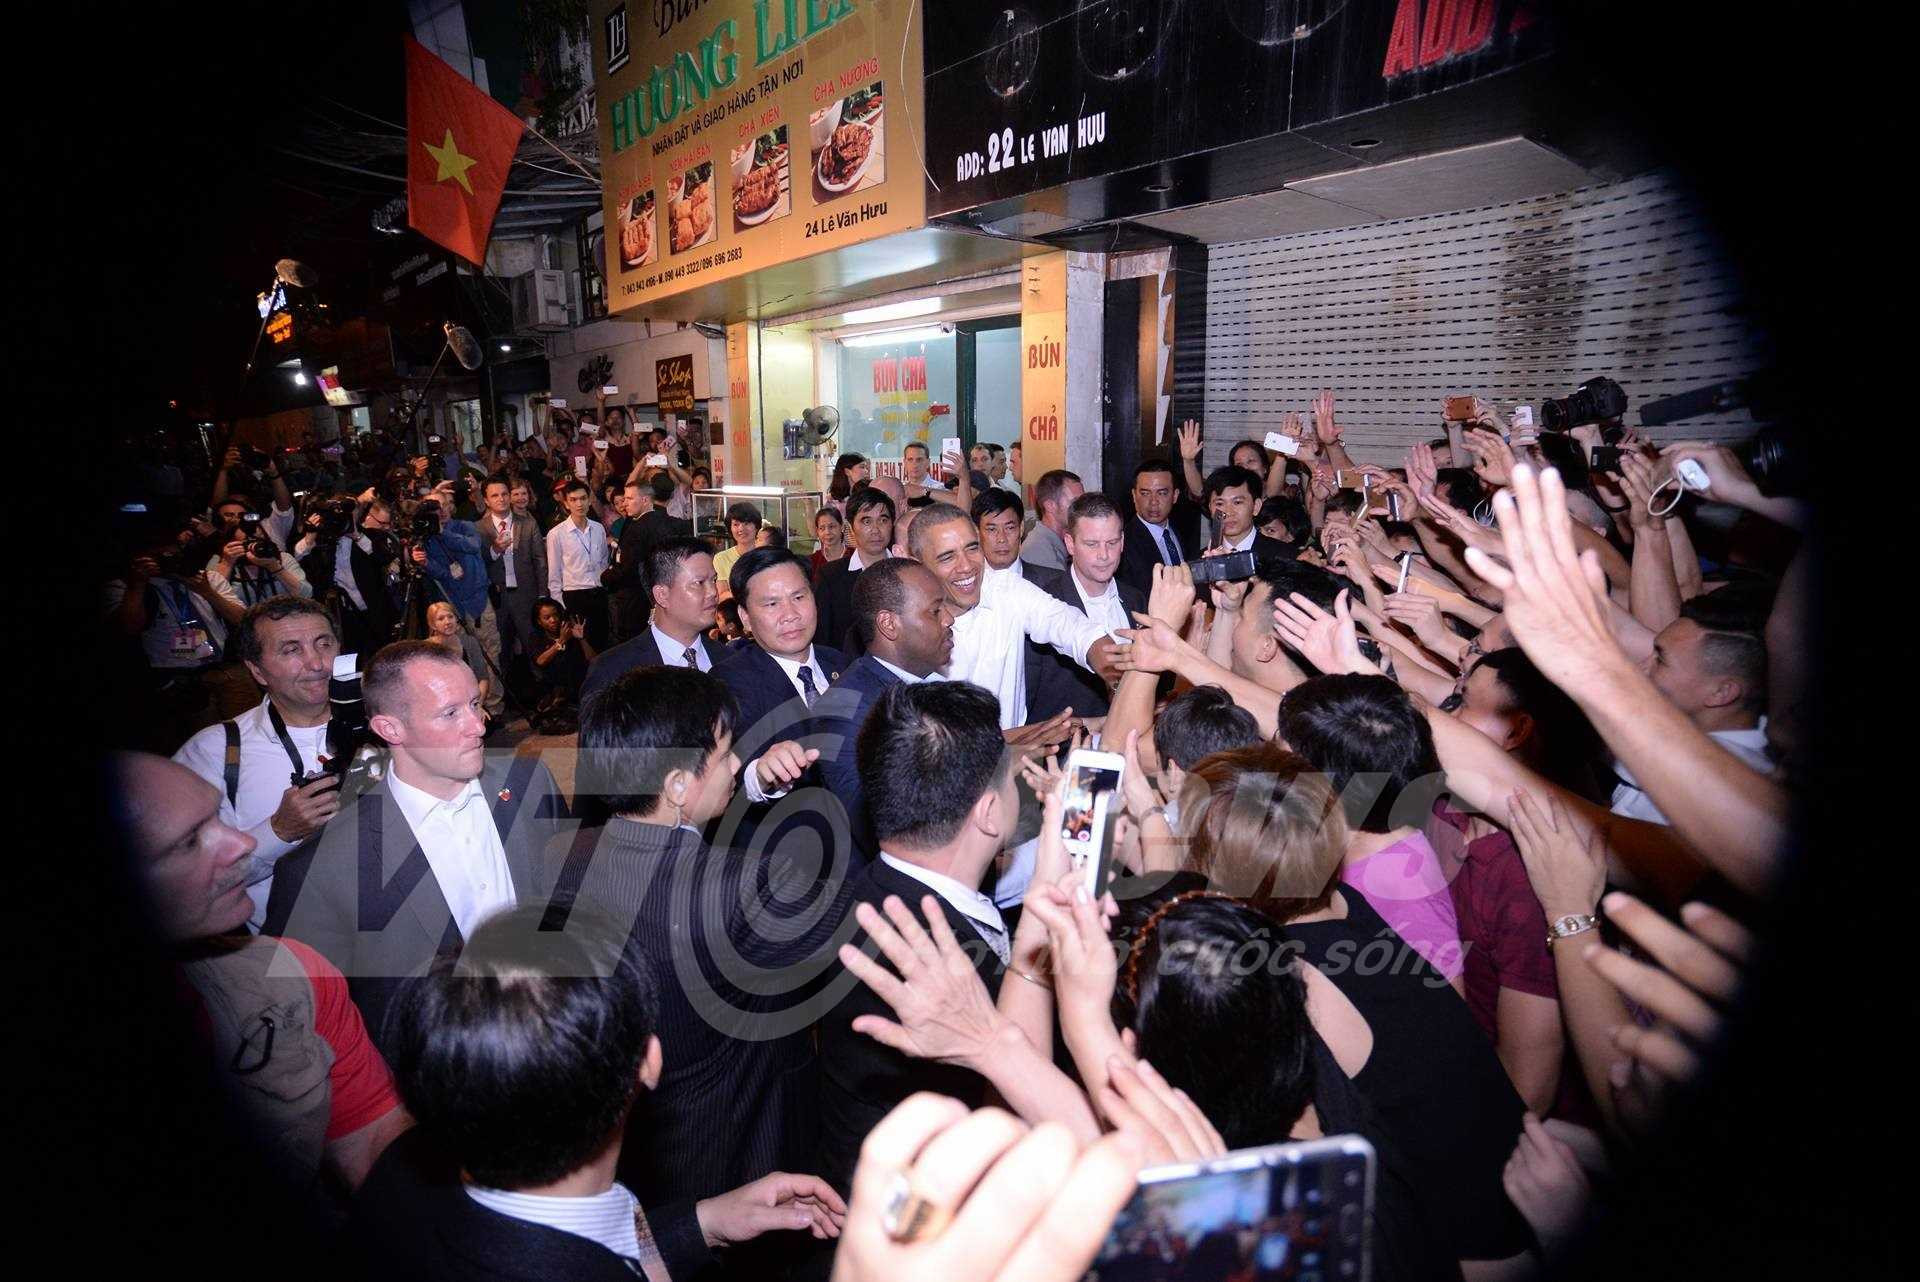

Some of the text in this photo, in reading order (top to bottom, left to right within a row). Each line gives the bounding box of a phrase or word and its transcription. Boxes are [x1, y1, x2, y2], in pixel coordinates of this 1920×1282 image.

[703, 104, 726, 130] GIAO
[727, 88, 756, 116] HÀNG
[956, 112, 1106, 183] ADD: 22 LE VAN HUU
[805, 221, 819, 239] 24
[821, 215, 835, 234] Lê
[836, 210, 858, 229] Văn
[727, 246, 743, 262] 2683
[1028, 335, 1061, 369] BÚN
[731, 376, 747, 400] BÚN
[1029, 404, 1059, 441] CHẢ
